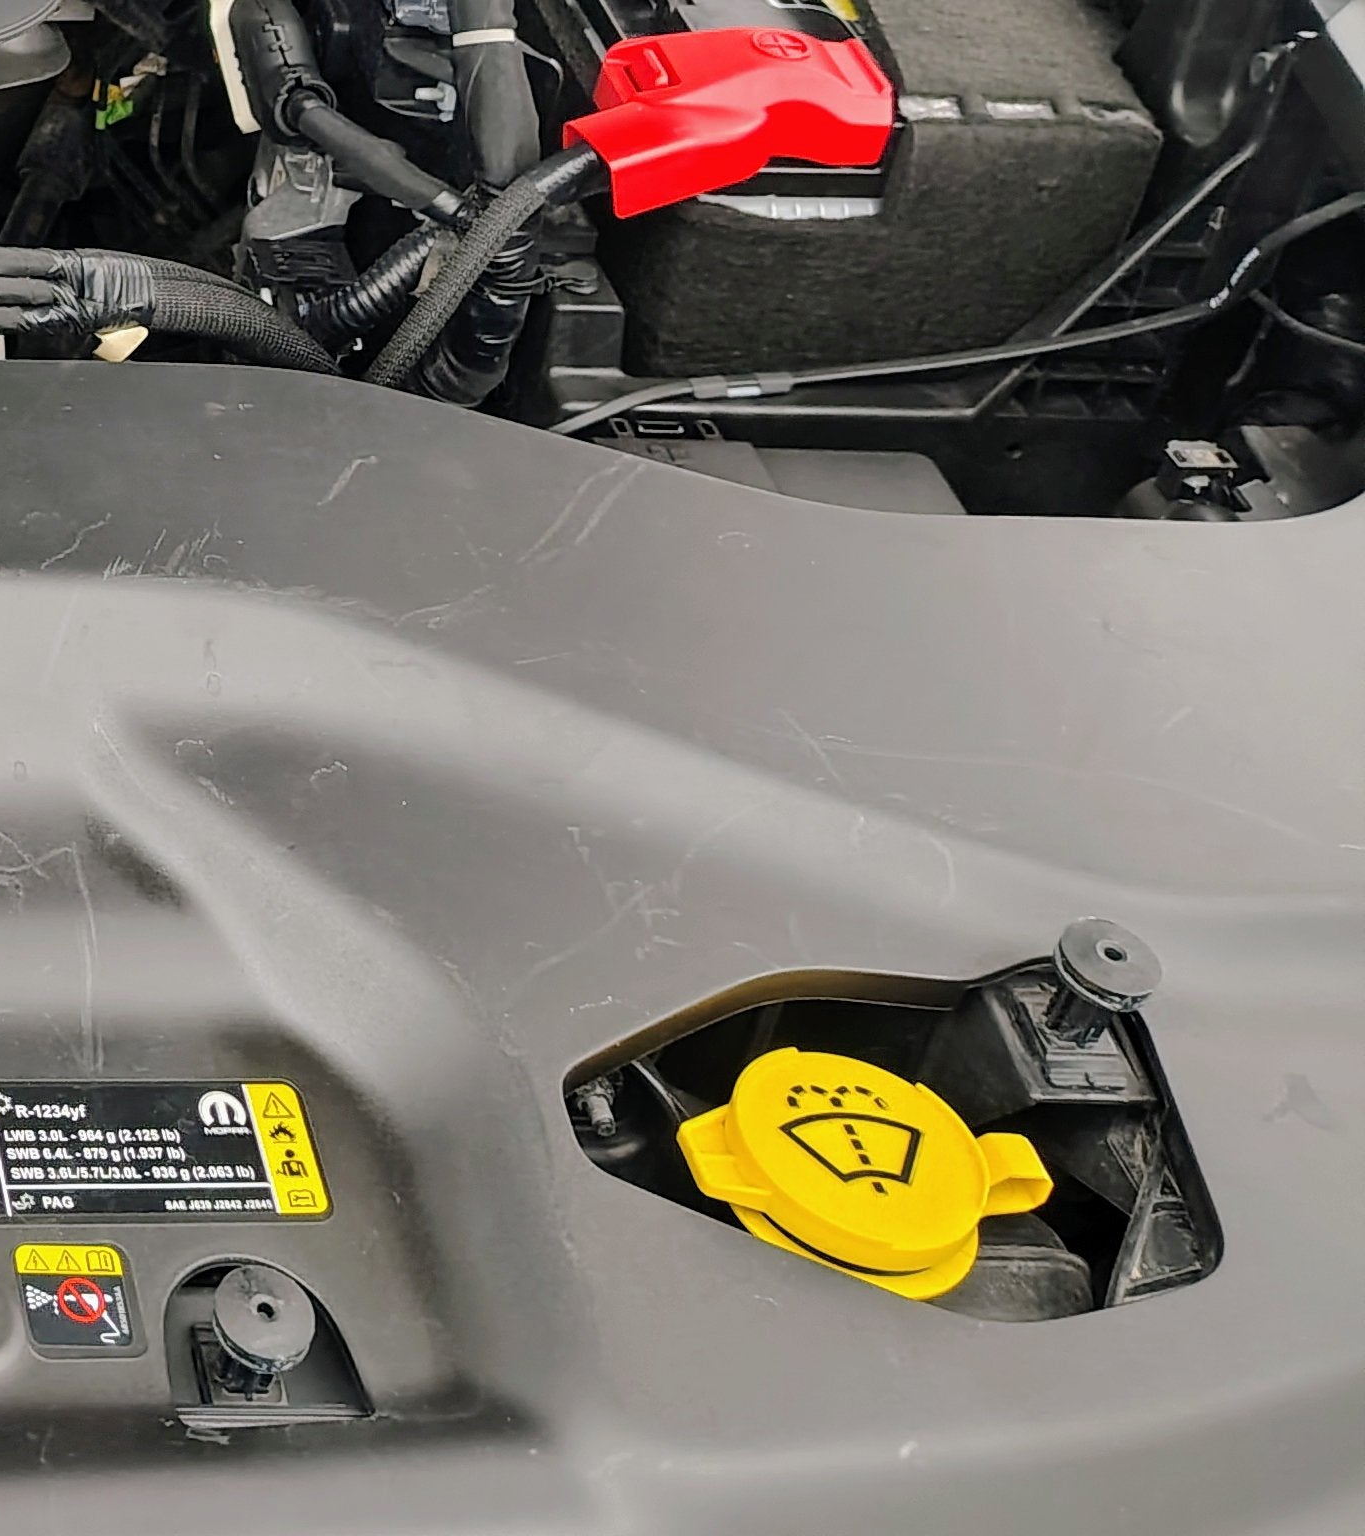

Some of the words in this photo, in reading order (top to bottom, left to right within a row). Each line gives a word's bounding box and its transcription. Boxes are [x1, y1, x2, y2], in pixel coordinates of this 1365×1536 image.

[14, 1103, 87, 1122] R-1234yf
[3, 1129, 37, 1142] LWB
[38, 1129, 68, 1142] 3.0L
[78, 1129, 104, 1142] 964
[106, 1131, 117, 1144] g
[118, 1128, 158, 1144] (2.125
[161, 1128, 181, 1143] lb)
[6, 1147, 39, 1161] SWB
[42, 1147, 70, 1160] 6.4L
[110, 1150, 121, 1162] g
[166, 1146, 186, 1161] lb)
[10, 1166, 44, 1179] SWB
[180, 1168, 191, 1181] g
[236, 1165, 255, 1180] lb)
[41, 1195, 75, 1209] PAG
